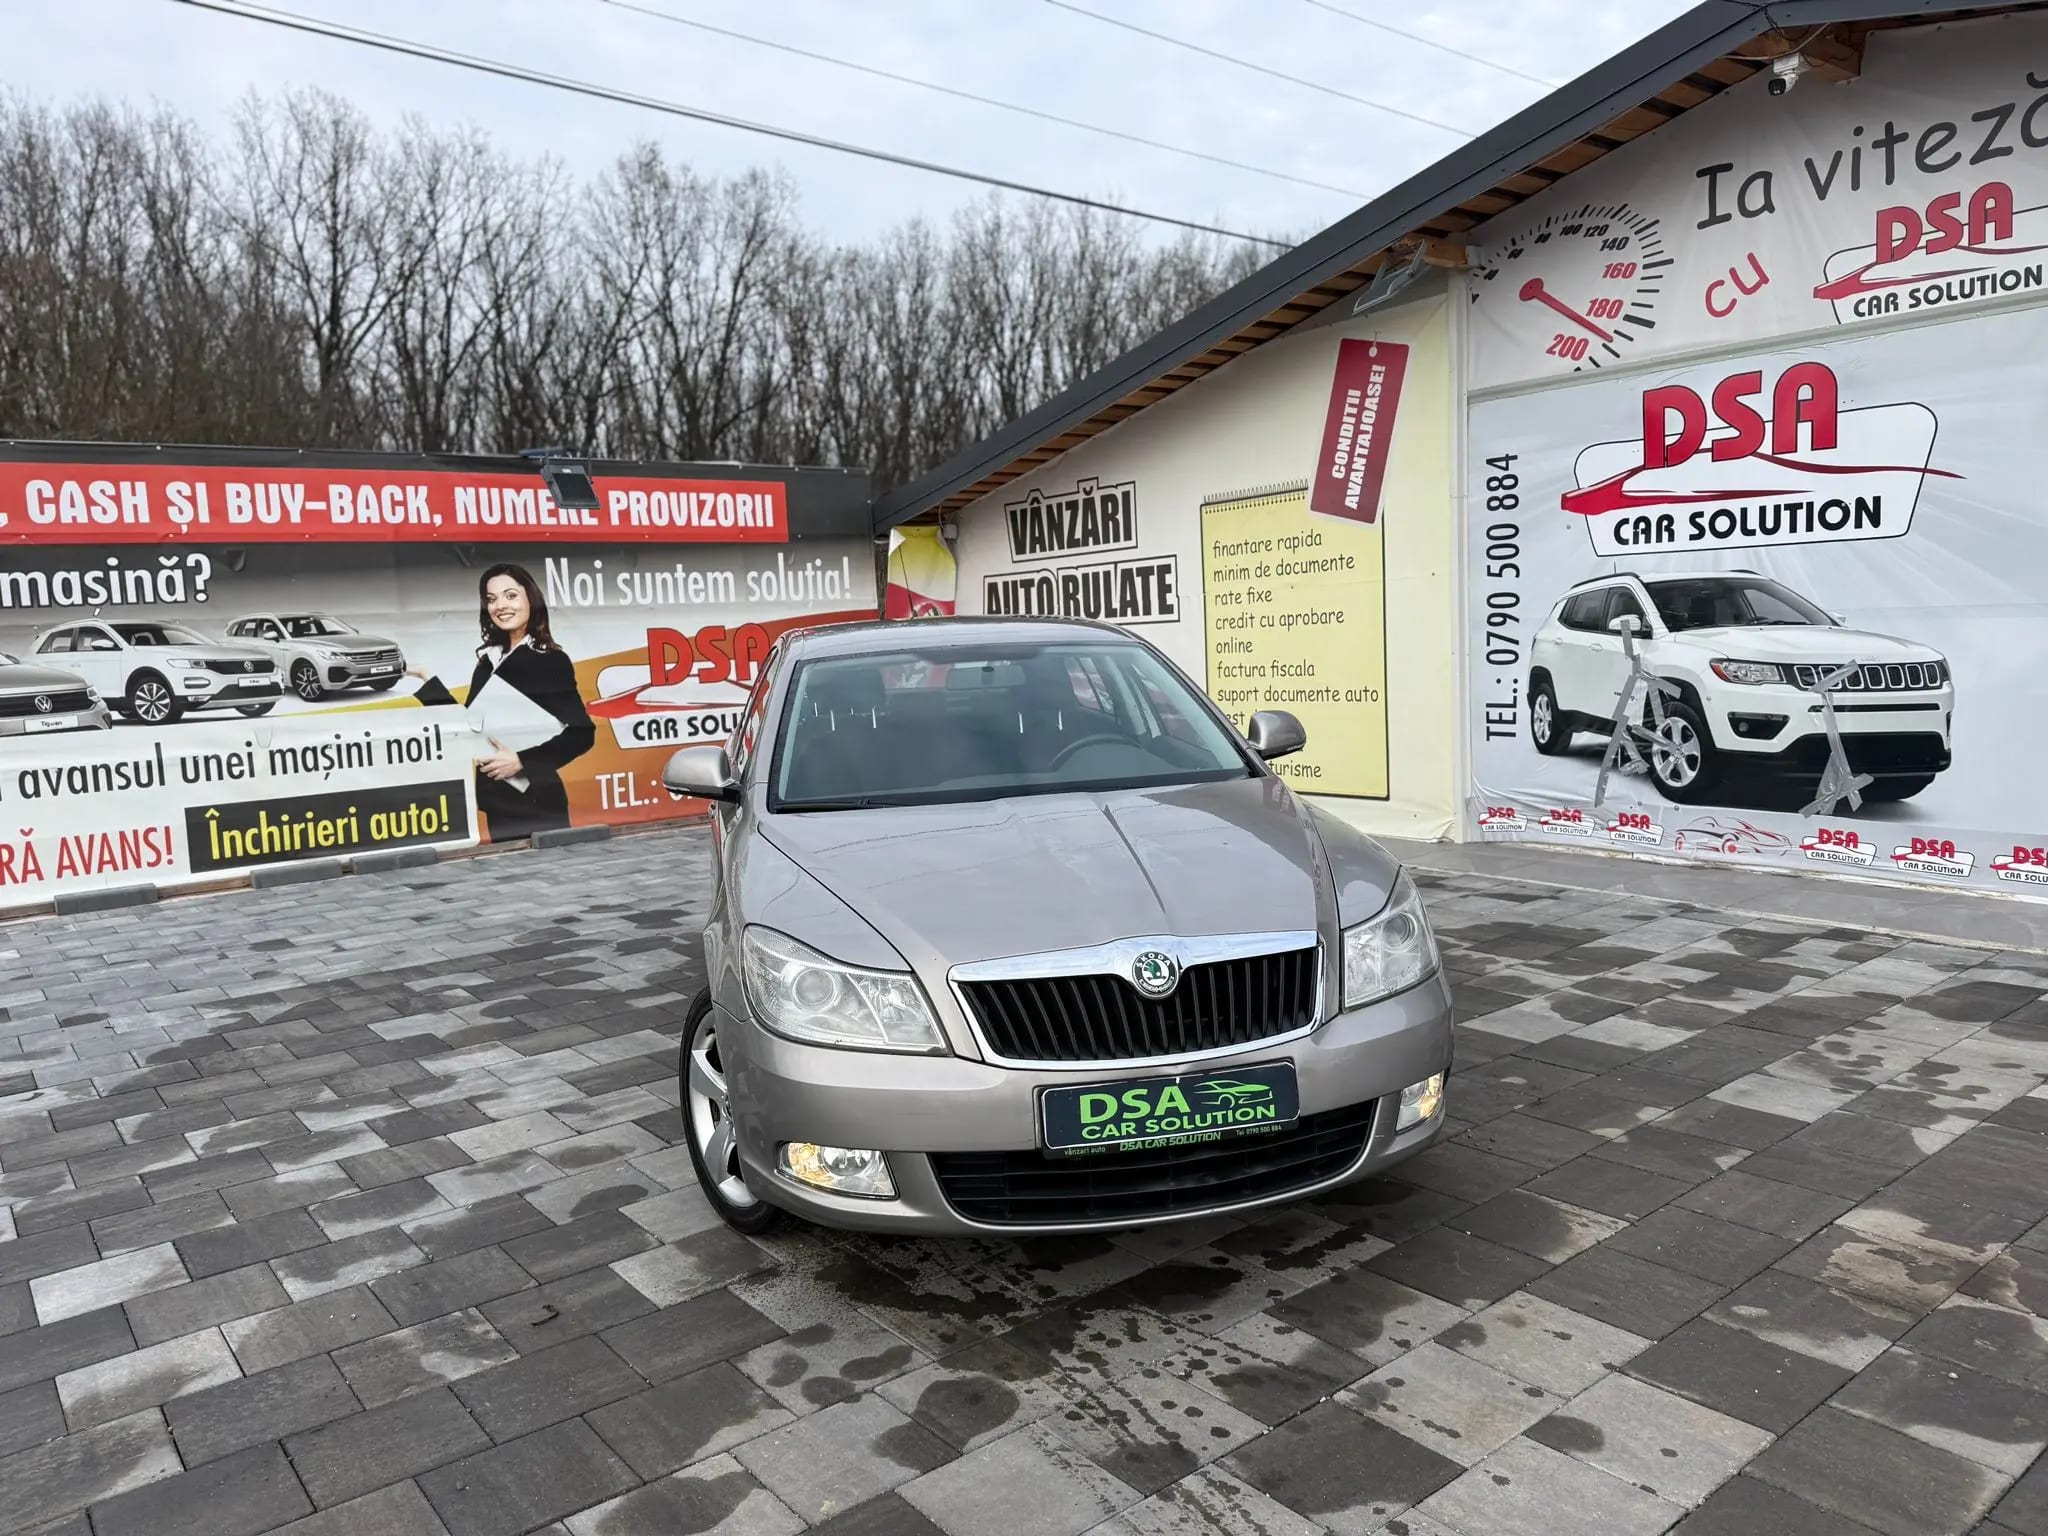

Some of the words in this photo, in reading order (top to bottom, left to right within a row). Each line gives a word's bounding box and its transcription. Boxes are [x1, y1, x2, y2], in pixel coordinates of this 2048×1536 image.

[1695, 162, 1776, 231] Ia
[1559, 223, 1583, 236] 100
[1583, 224, 1609, 238] 120
[1876, 181, 2014, 265] DSA
[1600, 236, 1630, 252] 140
[1602, 262, 1638, 279] 160
[1704, 251, 1770, 318] cu
[1853, 290, 1900, 319] CAR
[1908, 263, 2044, 302] SOLUTION
[1585, 297, 1624, 320] 180
[1545, 333, 1590, 361] 200
[1642, 361, 1839, 470] DSA
[1331, 388, 1362, 480] CONDITII
[1344, 364, 1386, 511] AVANTAJOASE!
[1485, 453, 1520, 512] 884
[25, 479, 150, 524] CASH
[165, 480, 211, 535] ȘI
[224, 482, 443, 527] BUY-BACK,
[608, 490, 774, 528] PROVIZORII
[1009, 485, 1133, 556] VÂNZĂRI
[1613, 512, 1676, 546] CAR
[1688, 495, 1882, 542] SOLUTION
[1212, 539, 1273, 559] finantare
[1277, 528, 1323, 555] rapida
[1485, 522, 1521, 579] 500
[544, 557, 605, 608] Noi
[616, 563, 736, 606] suntem
[1213, 563, 1250, 583] minim
[1254, 560, 1272, 579] de
[1275, 553, 1356, 577] documente
[986, 576, 1055, 615] AUTO
[1061, 563, 1175, 620] RULATE
[1215, 590, 1243, 606] rate
[1246, 586, 1273, 605] fixe
[1215, 612, 1255, 631] credit
[1259, 614, 1275, 628] cu
[1279, 607, 1345, 632] aprobare
[1485, 591, 1521, 666] 0790
[646, 622, 771, 687] DSA
[1216, 636, 1254, 654] online
[1217, 660, 1266, 679] factura
[1270, 659, 1315, 679] fiscala
[1217, 686, 1260, 706] suport
[1264, 685, 1341, 703] documente
[1345, 685, 1379, 703] auto
[1485, 677, 1519, 742] TEL.:
[632, 716, 679, 741] CAR
[18, 742, 166, 799] avansul
[180, 741, 256, 784] unei
[269, 731, 374, 781] mașini
[386, 723, 444, 765] noi!
[1267, 760, 1322, 778] turisme
[595, 771, 659, 810] TEL.:
[204, 806, 359, 860] Închirieri
[370, 794, 450, 841] auto!
[1487, 806, 1516, 819] DSA
[1550, 809, 1583, 823] DSA
[1618, 812, 1651, 830] DSA
[1559, 827, 1588, 835] SOLUTION
[1627, 834, 1657, 843] SOLUTION
[1818, 828, 1859, 849] DSA
[56, 826, 174, 879] AVANS!
[1810, 851, 1826, 859] CAR
[1827, 852, 1867, 864] SOLUTION
[1911, 837, 1956, 859] DSA
[2013, 846, 2048, 867] DS
[1921, 863, 1964, 875] SOLUTION
[2004, 871, 2022, 880] CAR
[1079, 1085, 1191, 1124] DSA
[1081, 1121, 1137, 1140] CAR
[1145, 1104, 1276, 1133] SOLUTION
[1119, 1141, 1143, 1152] DSA
[1144, 1138, 1168, 1149] CAR
[1169, 1131, 1221, 1146] SOLUTION
